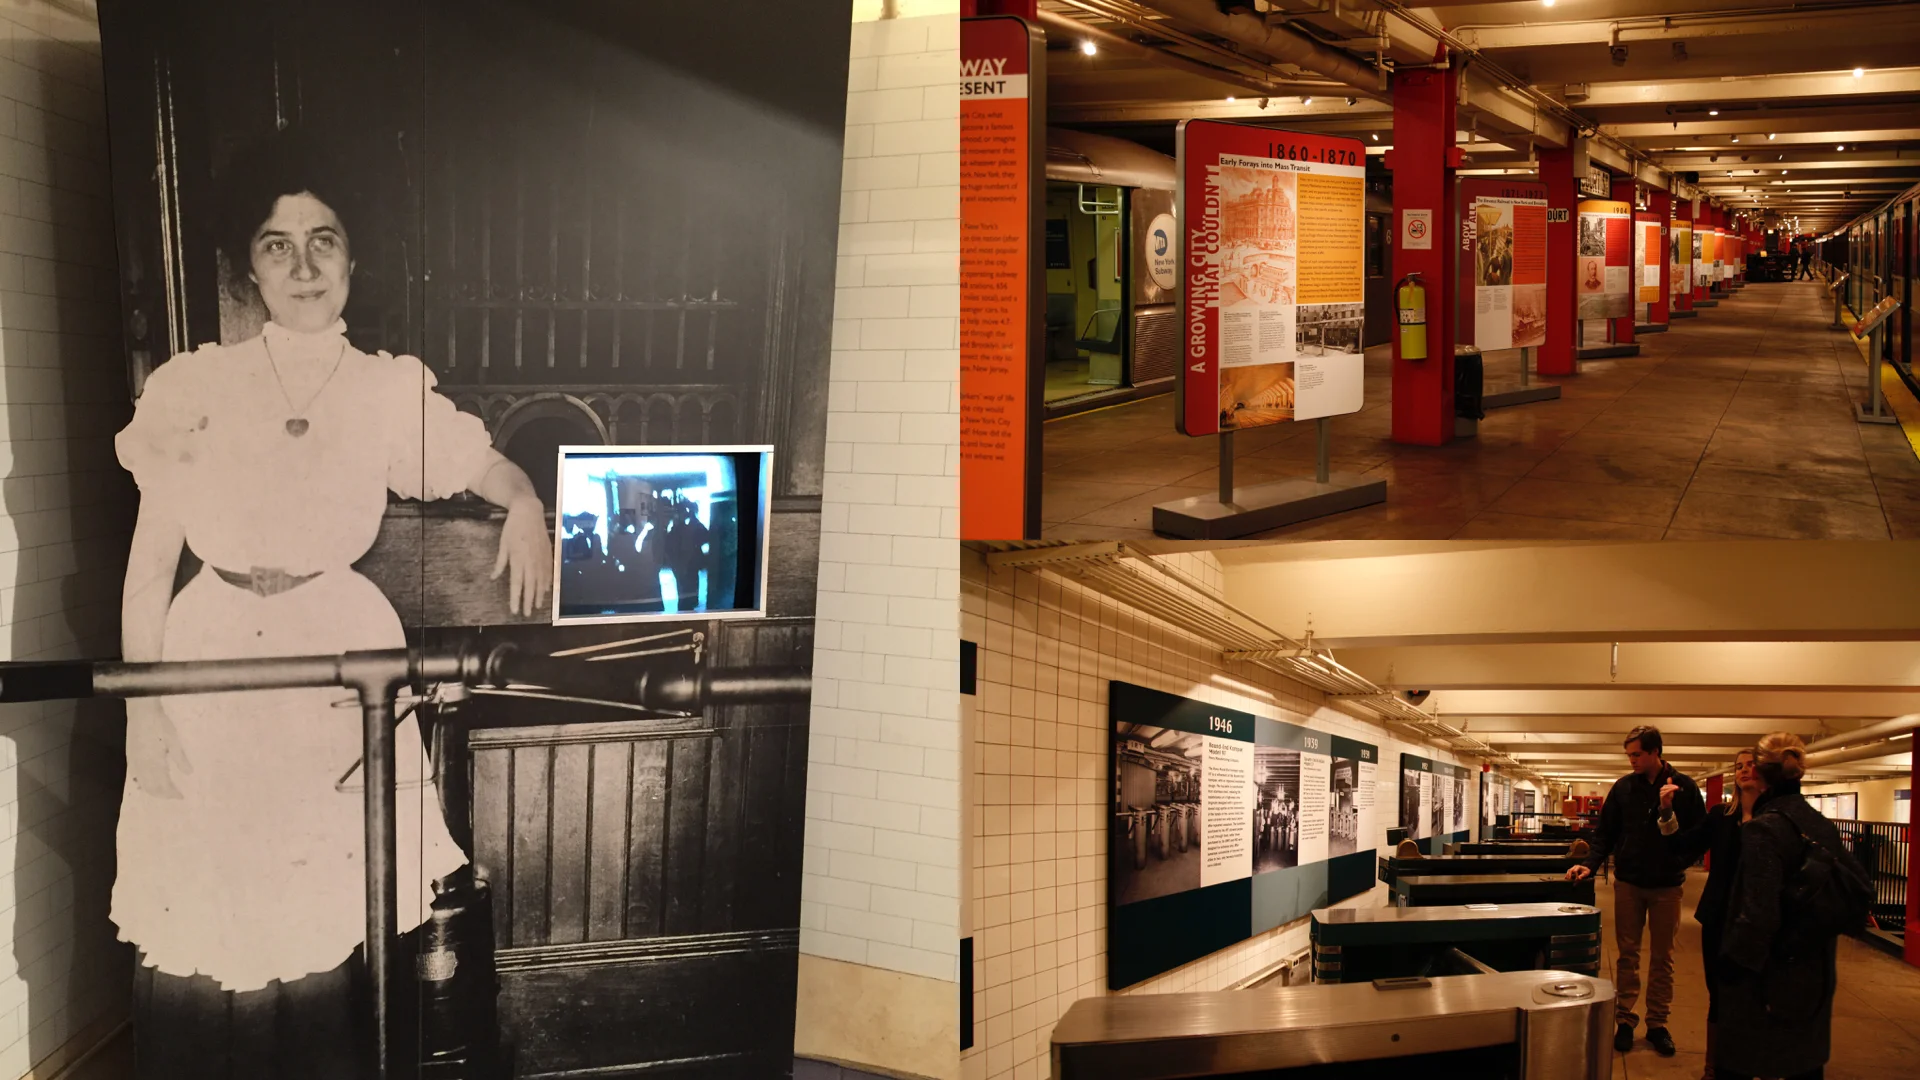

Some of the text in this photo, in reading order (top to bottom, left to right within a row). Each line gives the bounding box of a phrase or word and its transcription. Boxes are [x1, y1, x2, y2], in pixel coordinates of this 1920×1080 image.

[960, 58, 1007, 76] WAY
[1268, 142, 1357, 167] 1860-1870
[1220, 157, 1237, 167] Early
[1239, 159, 1259, 168] Forays
[1290, 164, 1310, 172] Transit
[1469, 203, 1477, 223] ALL
[1205, 167, 1220, 305] THAT COULDN'T
[1462, 219, 1470, 251] ABOVE
[1155, 258, 1175, 266] New York
[1155, 267, 1173, 276] Subway
[1191, 274, 1206, 358] GROWING
[1191, 361, 1206, 373] A
[1209, 716, 1233, 734] 1946
[1304, 736, 1319, 750] 1939
